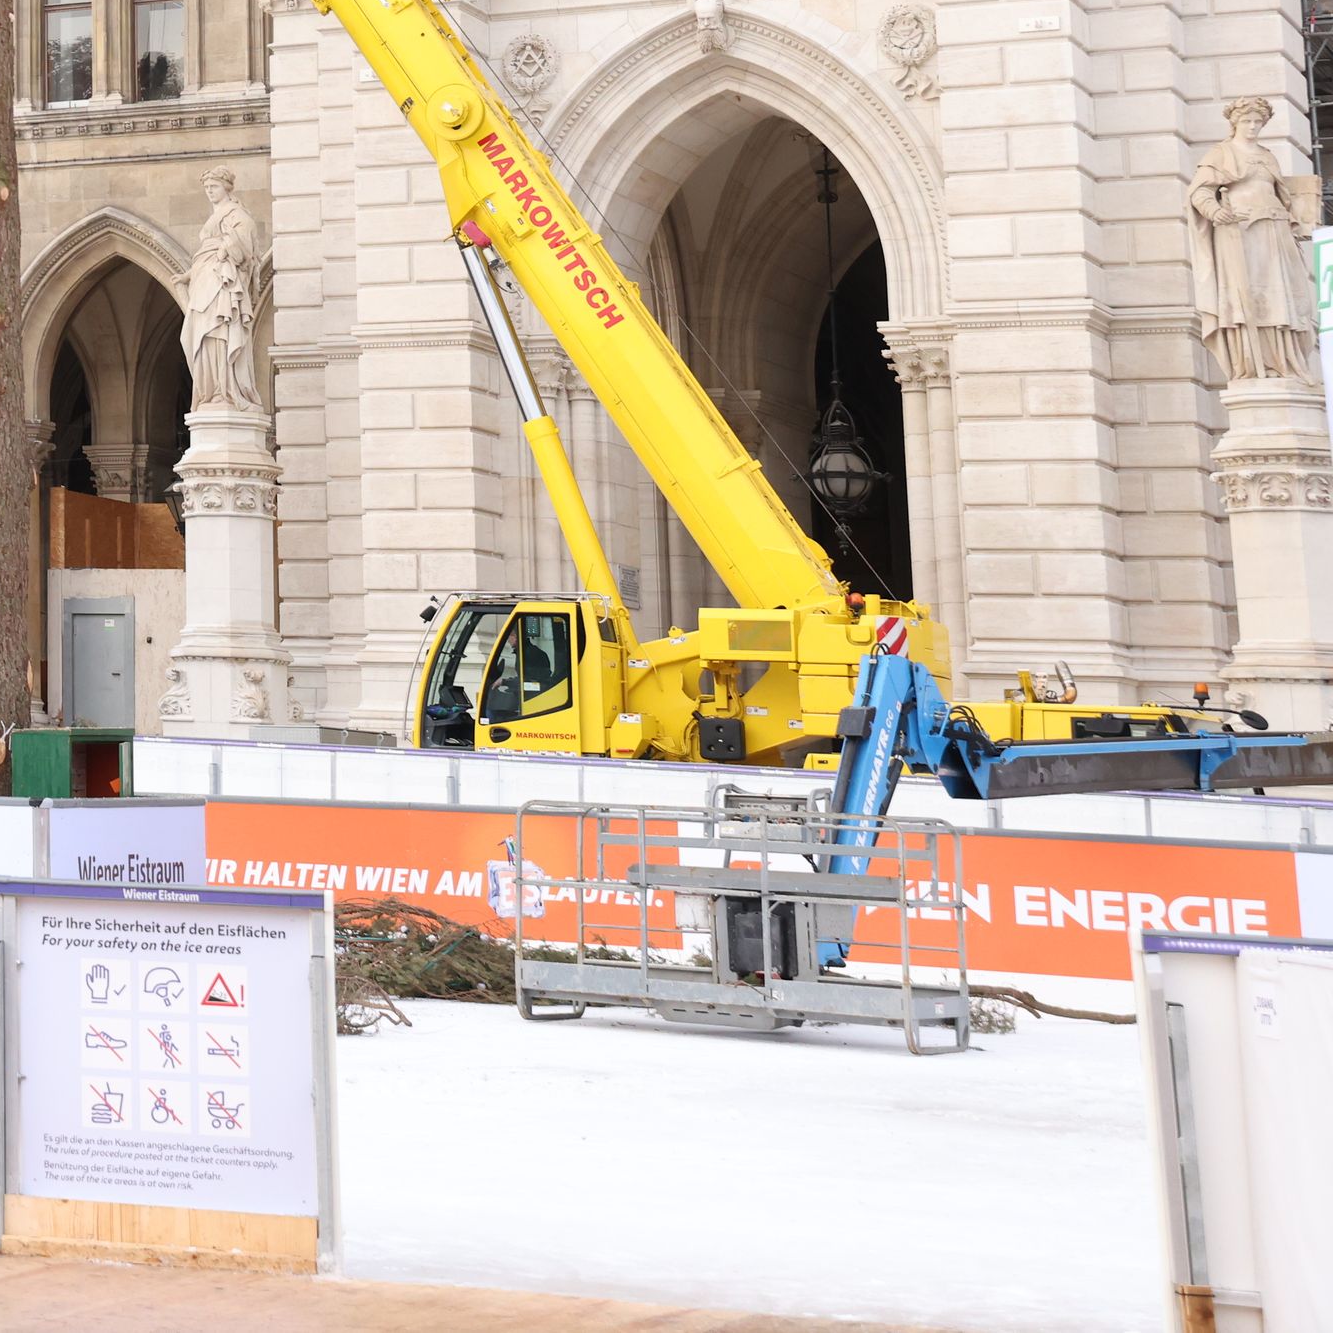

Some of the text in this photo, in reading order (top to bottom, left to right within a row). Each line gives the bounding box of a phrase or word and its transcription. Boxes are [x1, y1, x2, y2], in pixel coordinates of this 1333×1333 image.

[476, 132, 625, 330] MARKOWITSCH
[515, 730, 577, 741] MARKOWITSCH
[78, 853, 185, 884] Wiener Eistraum
[243, 861, 348, 889] HALTEN
[355, 865, 428, 894] WIEN
[433, 870, 483, 898] AM
[122, 888, 200, 902] Wiener Eistraum
[1013, 885, 1269, 937] ENERGIE
[41, 916, 286, 940] Für Ihre Sicherheit auf den Eisflächen
[41, 934, 242, 955] For your safety on the ice areas
[43, 1133, 53, 1142] Es
[54, 1134, 68, 1145] gilt
[70, 1135, 83, 1144] die
[97, 1137, 113, 1146] den
[115, 1138, 145, 1148] Kassen
[146, 1141, 211, 1154] angeschlagene
[212, 1144, 295, 1160] Geschäftsordnung.
[44, 1145, 59, 1154] The
[60, 1147, 80, 1155] rules
[81, 1147, 91, 1156] of
[91, 1149, 133, 1159] procedure
[134, 1152, 163, 1161] posted
[175, 1154, 189, 1162] the
[190, 1155, 213, 1164] ticket
[215, 1157, 251, 1167] counters
[253, 1160, 278, 1170] apply.
[43, 1160, 223, 1181] Benützung der Eisfläche auf eigene Gefahr.
